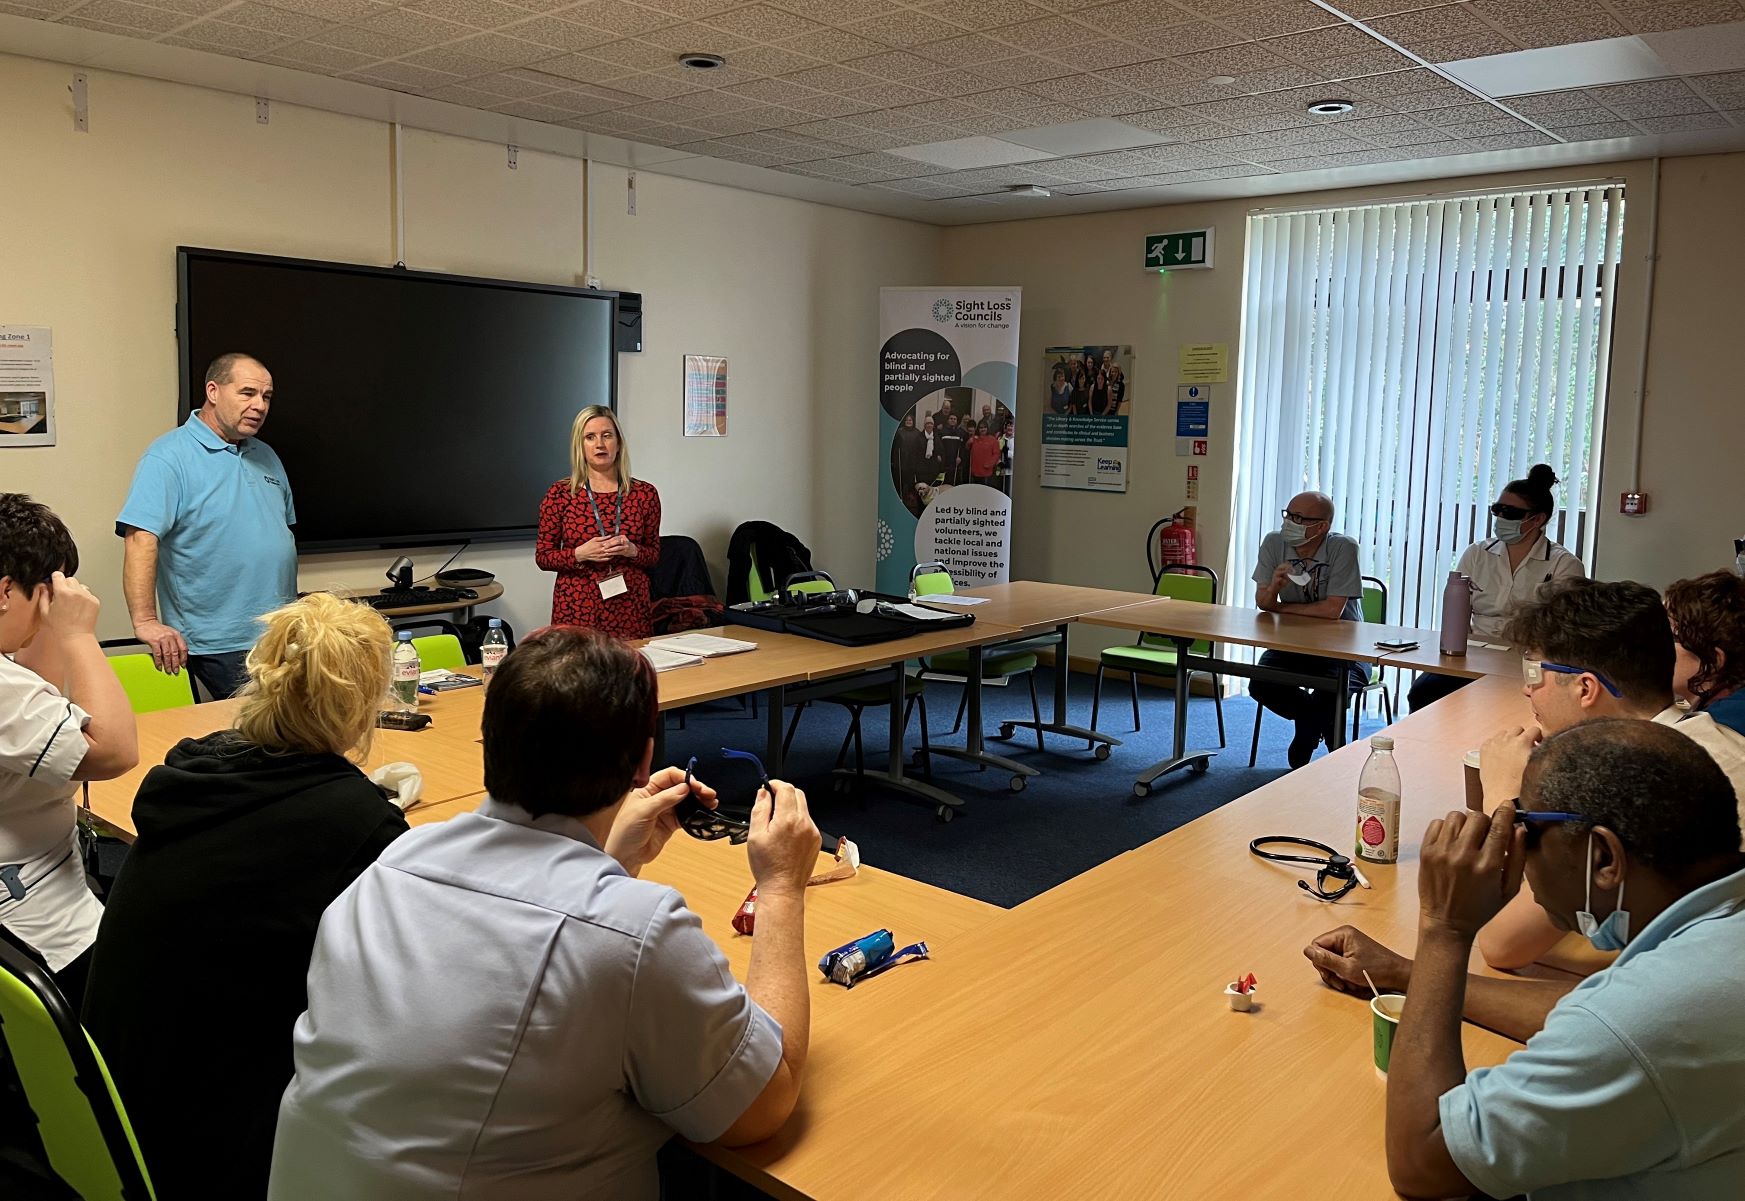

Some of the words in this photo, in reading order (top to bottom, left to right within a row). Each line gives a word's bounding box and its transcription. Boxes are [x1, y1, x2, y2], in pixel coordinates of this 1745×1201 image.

[955, 300, 985, 312] Sight
[987, 301, 1011, 310] Loss
[955, 311, 1002, 321] Councils
[884, 352, 935, 361] Advocating
[936, 352, 950, 360] for
[884, 362, 906, 370] blind
[884, 372, 920, 382] partially
[922, 374, 956, 383] sighted
[884, 384, 914, 392] people
[1097, 463, 1121, 472] Learning
[954, 507, 964, 516] by
[966, 508, 988, 516] blind
[935, 517, 970, 526] partially
[972, 518, 1005, 527] sighted
[935, 527, 983, 537] volunteers,
[963, 538, 984, 546] local
[934, 548, 969, 556] national
[971, 549, 998, 558] issues
[952, 558, 987, 568] improve
